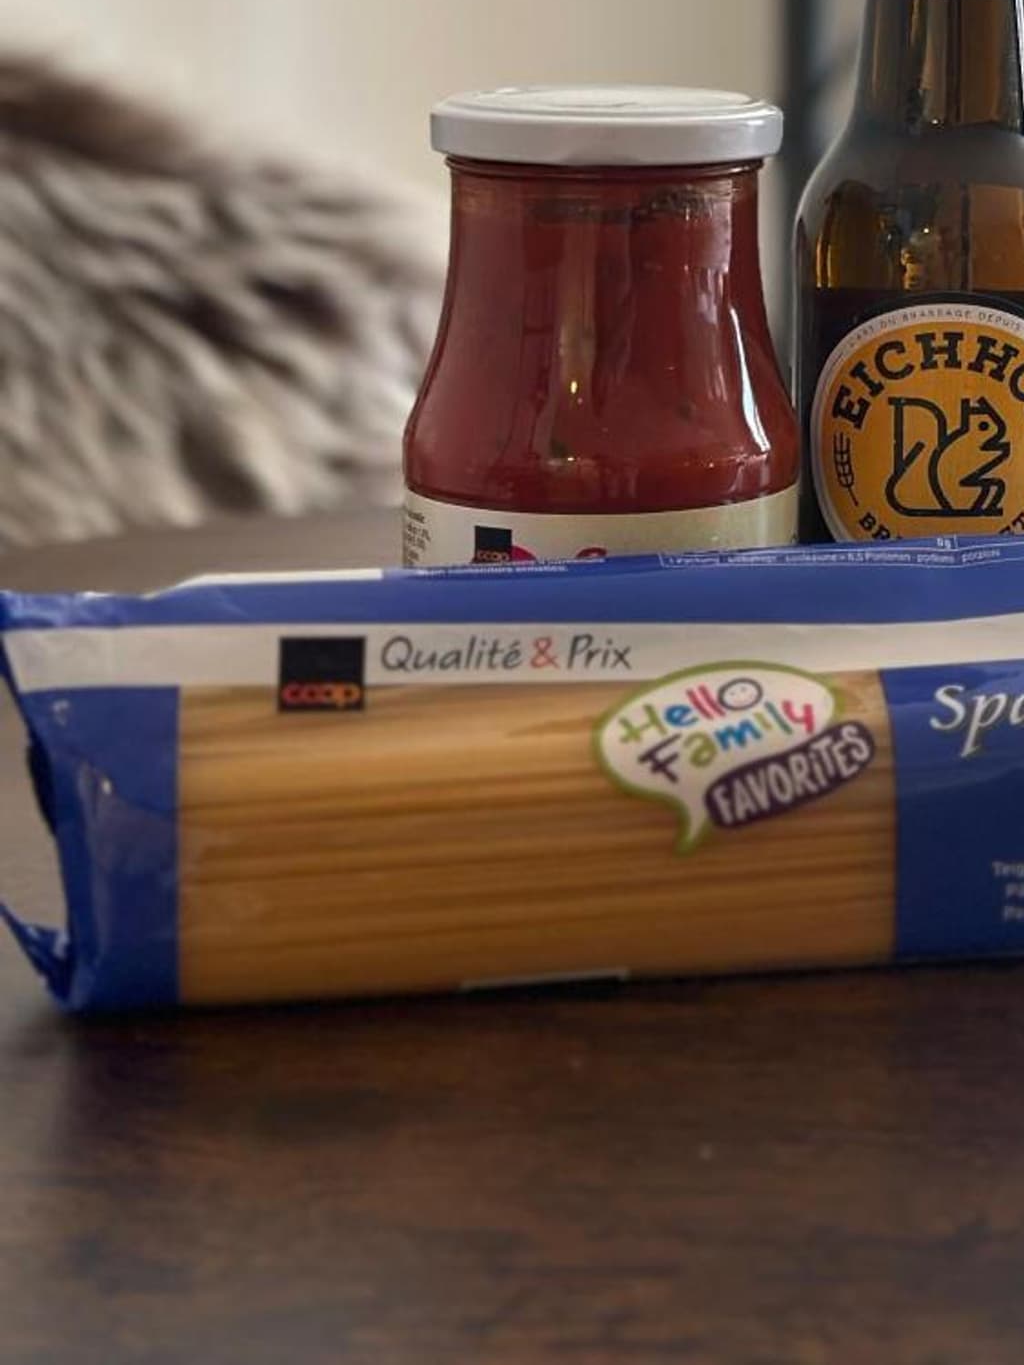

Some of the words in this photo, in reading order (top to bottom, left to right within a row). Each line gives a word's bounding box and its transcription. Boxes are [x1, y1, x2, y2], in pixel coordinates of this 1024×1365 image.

[902, 308, 973, 324] BRASSAGE
[978, 311, 1022, 333] DEPUIS
[380, 635, 522, 673] Qualité
[530, 636, 560, 670] &
[566, 634, 633, 671] Prix
[282, 683, 362, 708] coop
[637, 700, 815, 784] Family
